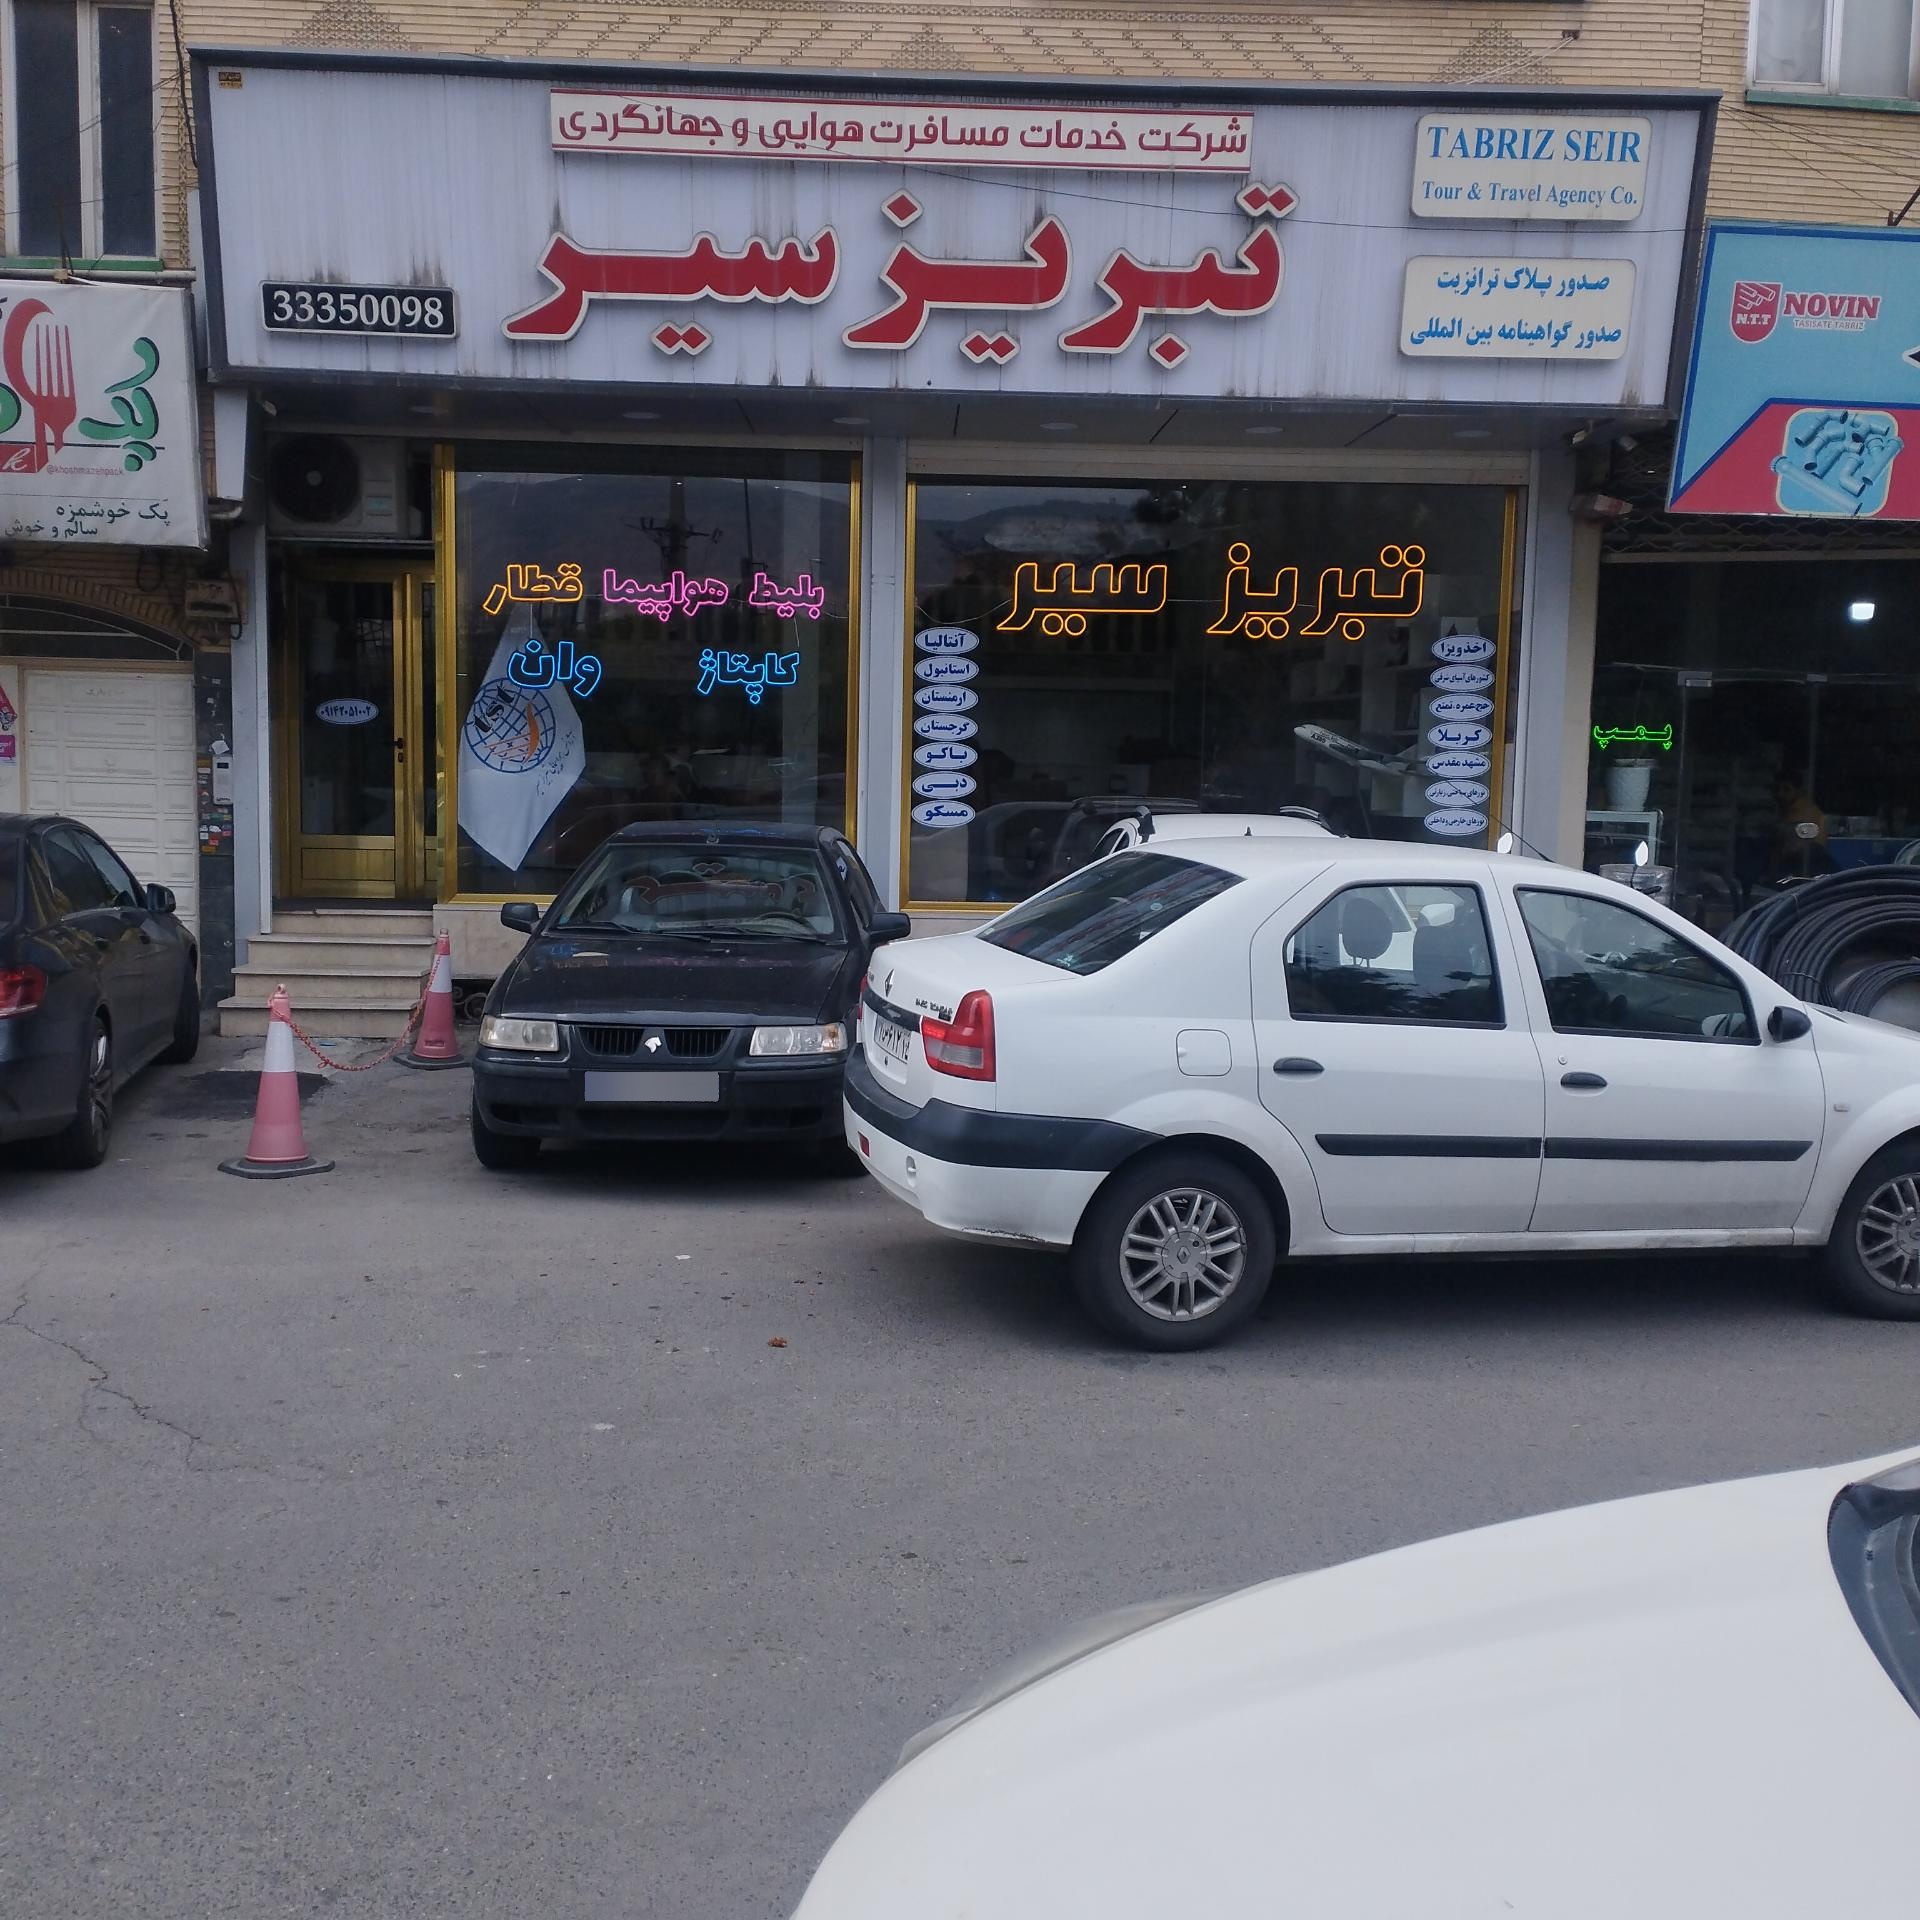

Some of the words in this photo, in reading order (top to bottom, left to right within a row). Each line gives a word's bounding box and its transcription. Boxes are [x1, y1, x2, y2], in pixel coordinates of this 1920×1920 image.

[558, 105, 723, 144] جهانگردی
[732, 119, 749, 145] و
[757, 110, 864, 150] هوایی
[869, 115, 1010, 153] مسافرت
[1019, 119, 1127, 151] خدمات
[1137, 116, 1247, 162] شرکت
[1427, 126, 1555, 161] TABRIZ
[1563, 129, 1642, 163] SEIR
[1423, 181, 1462, 199] Tour
[1467, 182, 1481, 200] &
[1489, 182, 1542, 202] Travel
[1546, 186, 1606, 208] Agency
[1610, 186, 1639, 205] Co.
[843, 182, 1298, 368] تبریز
[1436, 267, 1500, 295] ترانزیت
[1503, 267, 1553, 297] پلاک
[1555, 275, 1610, 297] صدور
[503, 226, 841, 356] سیر
[273, 290, 444, 329] 33350098
[1783, 293, 1881, 319] NOVIN
[1410, 317, 1463, 345] المللی
[1466, 324, 1494, 346] بین
[1498, 318, 1572, 347] گواهینامه
[1575, 326, 1622, 348] صدور
[55, 501, 131, 523] خوشمزه
[51, 526, 59, 538] و
[64, 521, 98, 538] سالم
[483, 563, 583, 615] قطار
[603, 568, 729, 621] هواپیما
[749, 572, 824, 619] بلیط
[996, 562, 1168, 636] سیر
[1206, 542, 1426, 640] تبریز
[924, 632, 966, 651] آنتالیا
[1440, 642, 1463, 657] ویزا
[1464, 641, 1487, 653] اخذ
[508, 639, 602, 697] وان
[923, 662, 970, 678] استانبول
[921, 689, 967, 706] ارمنستان
[920, 719, 970, 735] گرجستان
[1437, 729, 1482, 746] کربلا
[925, 746, 968, 763] باکو
[921, 777, 968, 793] دبی
[923, 804, 969, 821] مسکو
